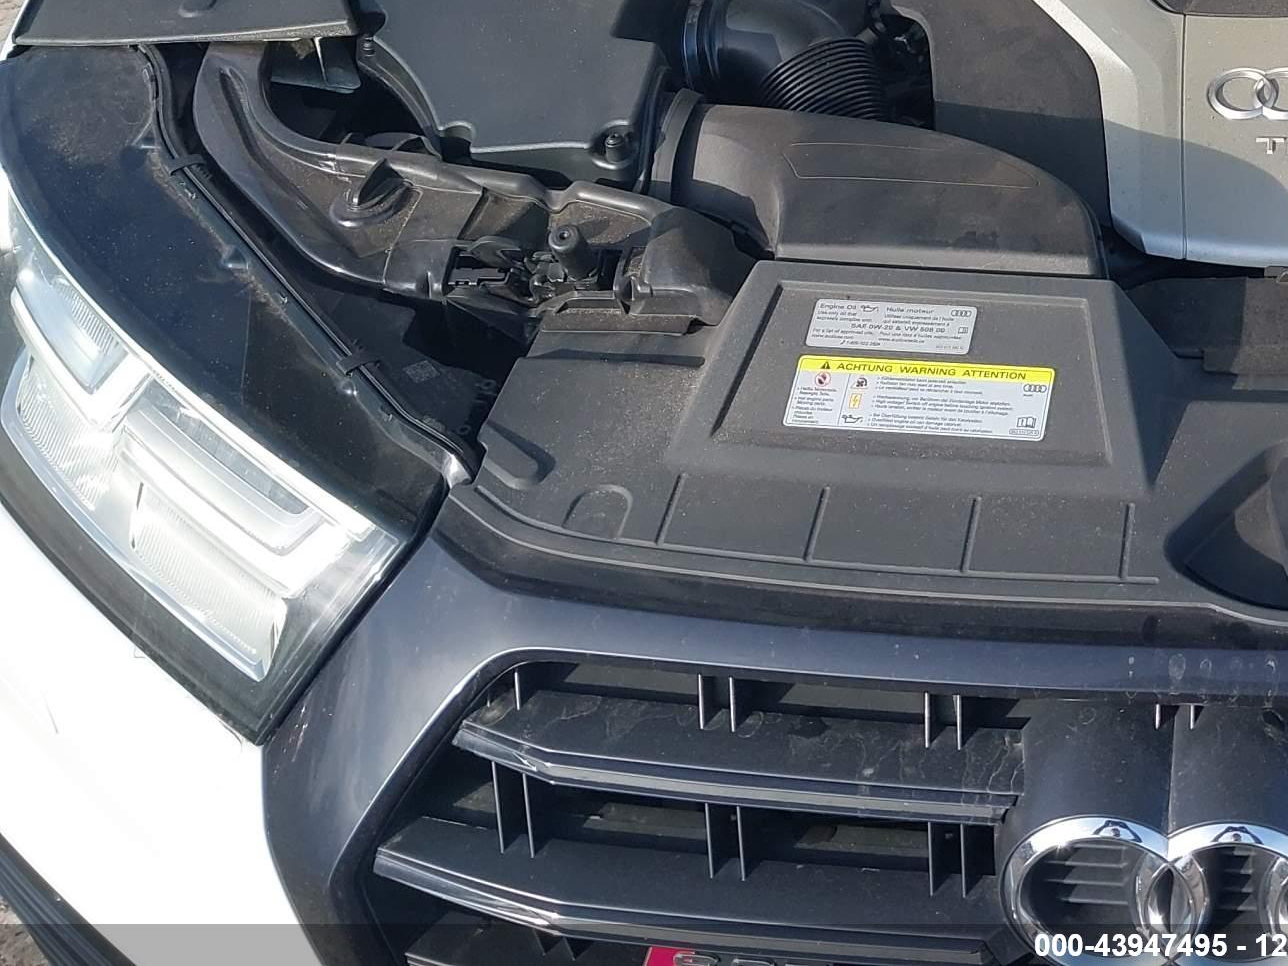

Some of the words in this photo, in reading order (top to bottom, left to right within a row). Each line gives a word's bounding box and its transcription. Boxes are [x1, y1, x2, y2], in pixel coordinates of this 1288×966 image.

[836, 363, 893, 373] ACHTUNG
[900, 366, 956, 376] WARNING
[962, 369, 1027, 380] ATTENTION
